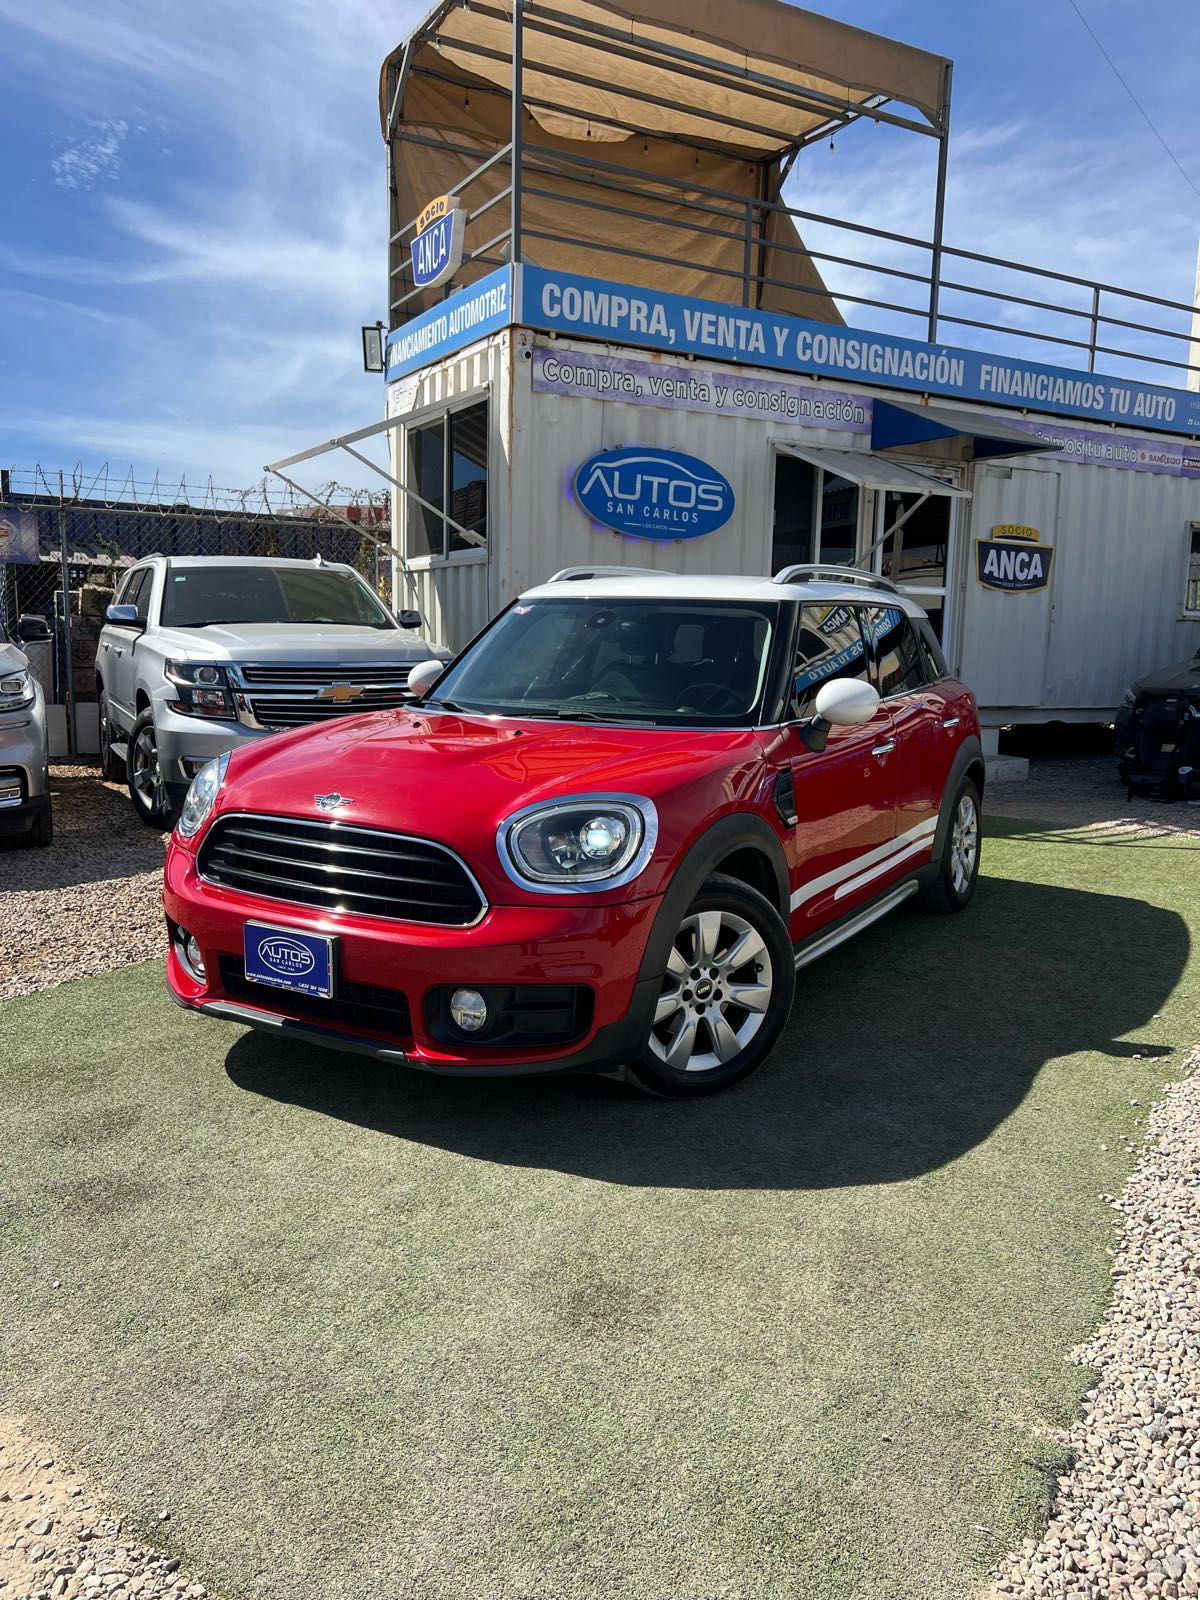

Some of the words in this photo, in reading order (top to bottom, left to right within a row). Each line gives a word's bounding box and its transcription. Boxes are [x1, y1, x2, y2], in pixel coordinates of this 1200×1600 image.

[419, 200, 445, 228] SOCIO
[417, 223, 447, 275] ANCA
[448, 283, 507, 335] AUTOMOTRIZ
[541, 283, 676, 345] COMPRA,
[683, 309, 766, 354] VENTA
[772, 326, 789, 357] Y
[796, 331, 965, 387] CONSIGNACIÓN
[979, 364, 1105, 410] FINANCIAMOS
[1109, 387, 1130, 415] TU
[1132, 392, 1176, 422] AUTO
[542, 357, 643, 397] Compra,
[650, 374, 711, 402] venta
[714, 385, 729, 408] y
[733, 387, 865, 425] consignación
[1087, 440, 1104, 458] tu
[1105, 445, 1137, 463] auto
[581, 468, 724, 511] AUTOS
[607, 501, 635, 515] SAN
[643, 505, 699, 523] CARLOS
[1000, 526, 1032, 537] SOCIO
[983, 549, 1043, 580] ANCA
[262, 944, 310, 964] AUTOS
